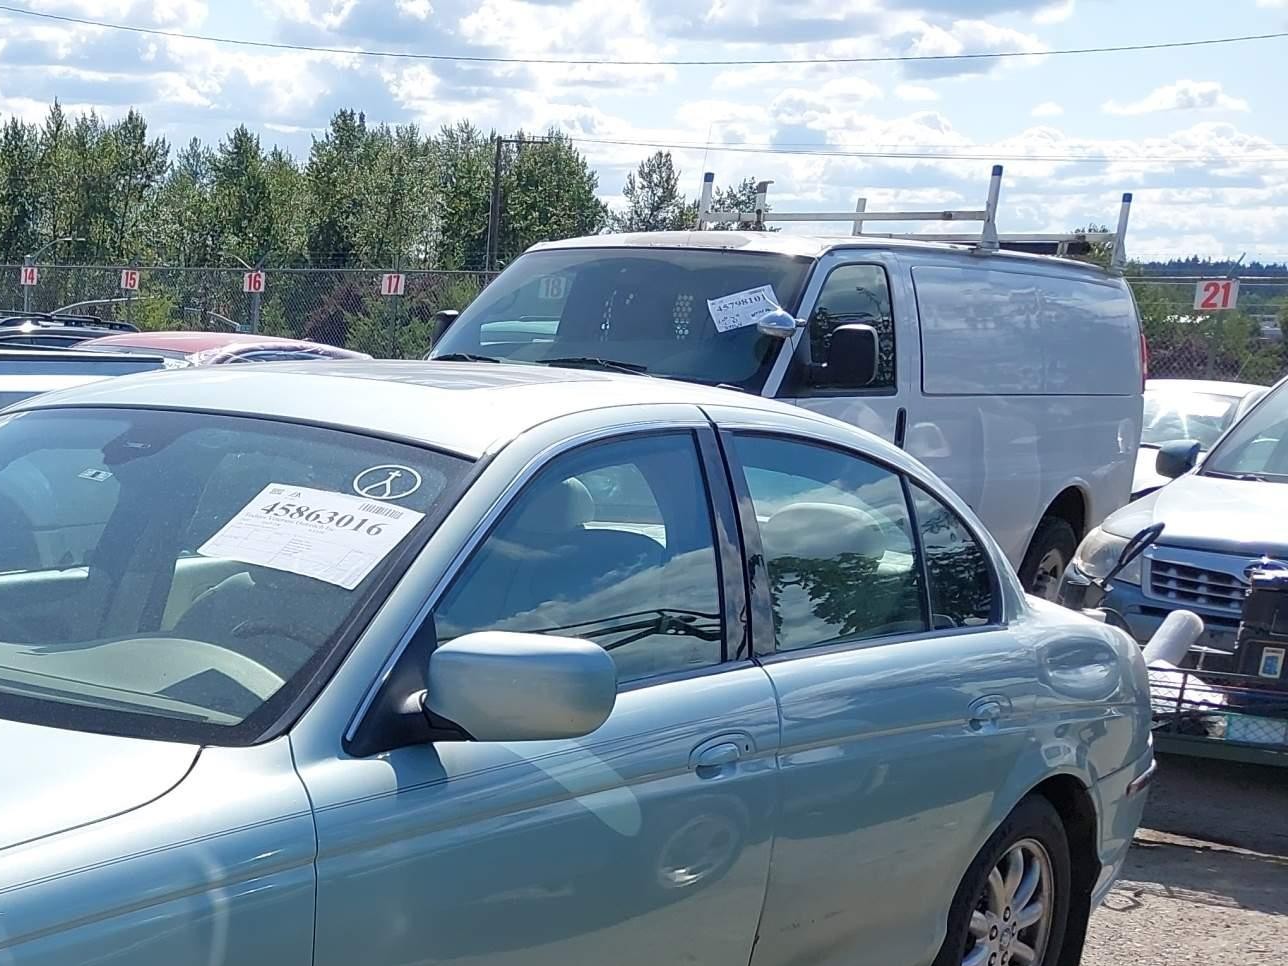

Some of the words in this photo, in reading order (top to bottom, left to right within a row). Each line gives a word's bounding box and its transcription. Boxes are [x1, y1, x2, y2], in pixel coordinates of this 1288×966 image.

[23, 268, 35, 284] 14
[124, 271, 137, 288] 15
[247, 273, 262, 291] 16
[386, 275, 400, 294] 17
[1201, 282, 1231, 308] 21
[260, 501, 389, 536] 45863016
